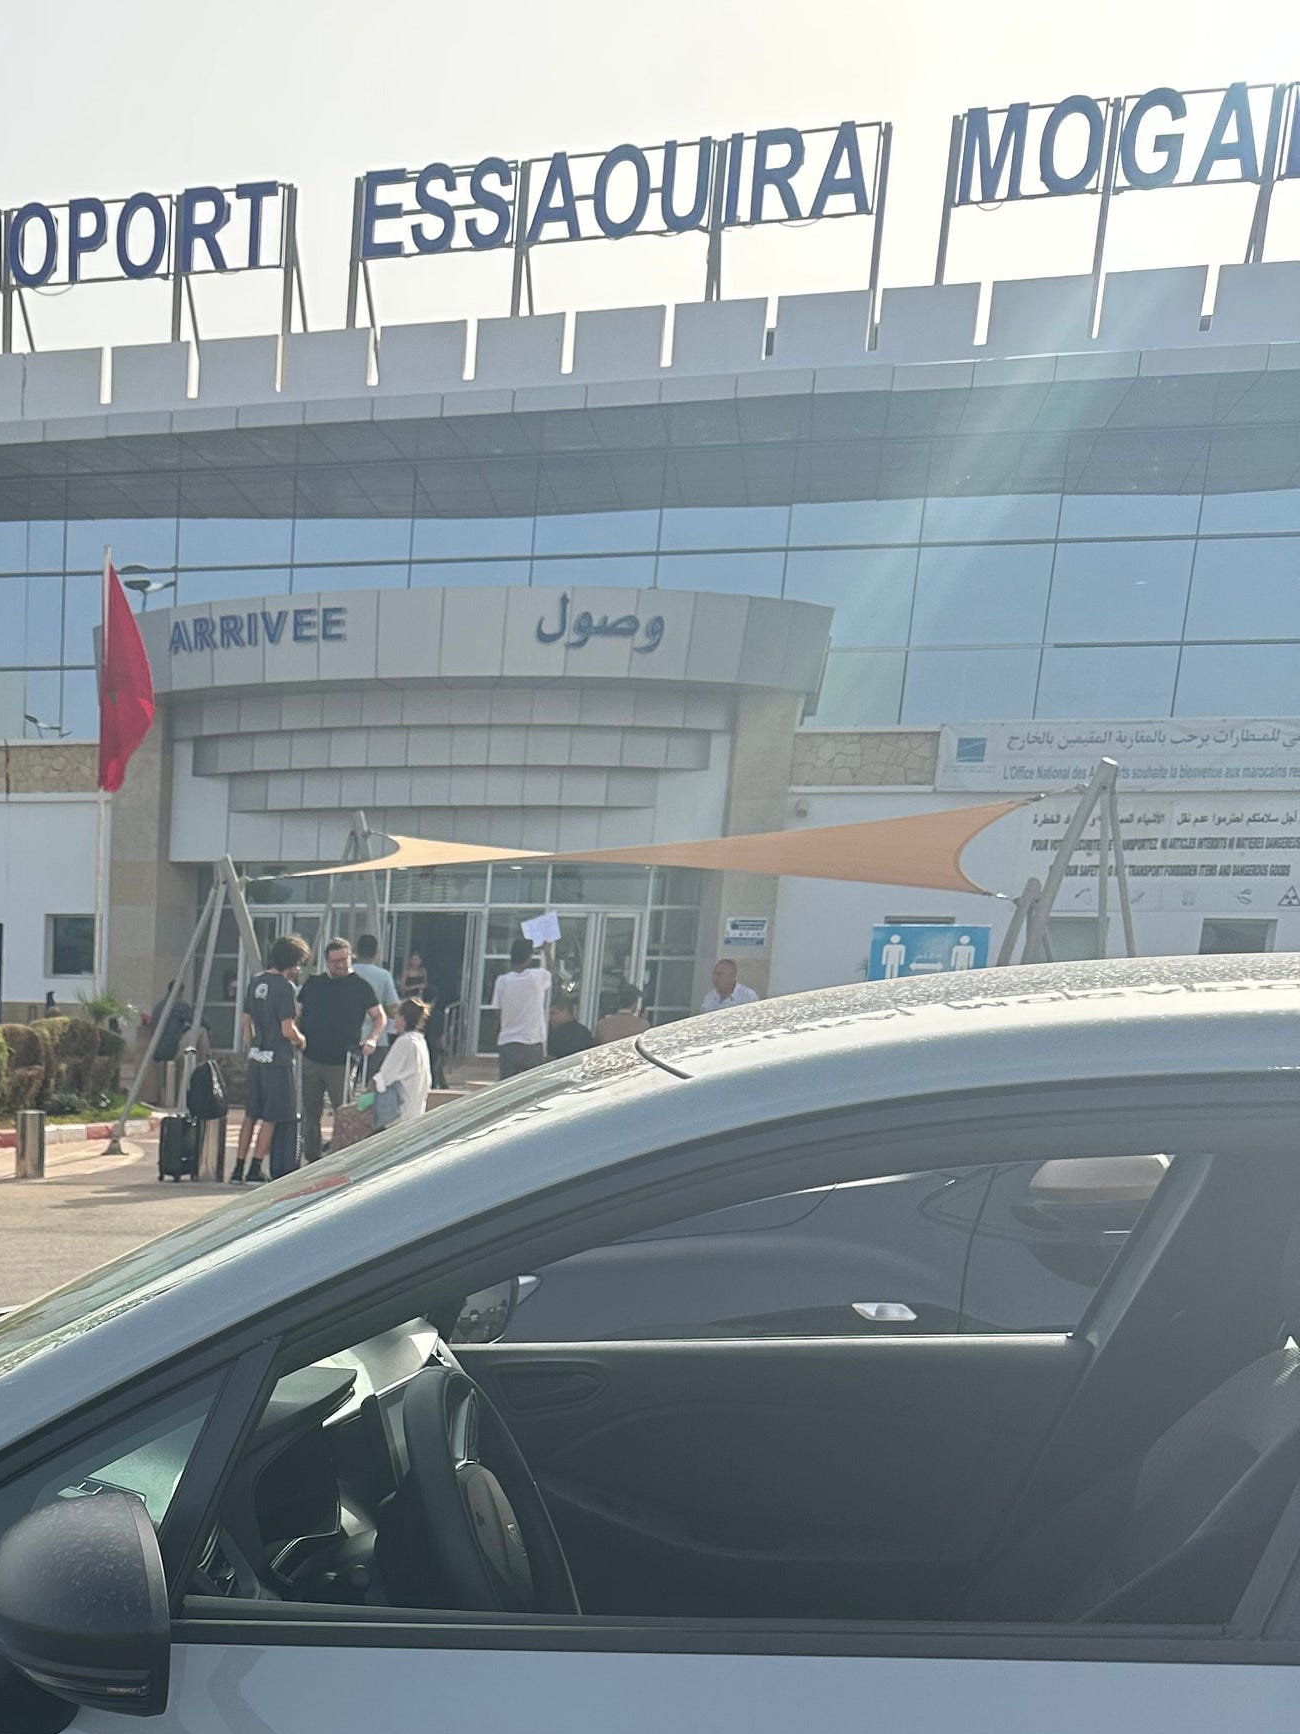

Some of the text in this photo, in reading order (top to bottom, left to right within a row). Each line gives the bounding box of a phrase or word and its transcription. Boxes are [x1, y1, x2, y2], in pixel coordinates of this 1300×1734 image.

[361, 120, 873, 259] ESSAOUIRA
[169, 606, 348, 655] ARRIVEE
[534, 591, 666, 654] وصول
[1007, 730, 1053, 750] بالخارج
[1057, 730, 1112, 750] المقيمين
[1170, 734, 1210, 748] يرحب
[1036, 765, 1071, 780] National
